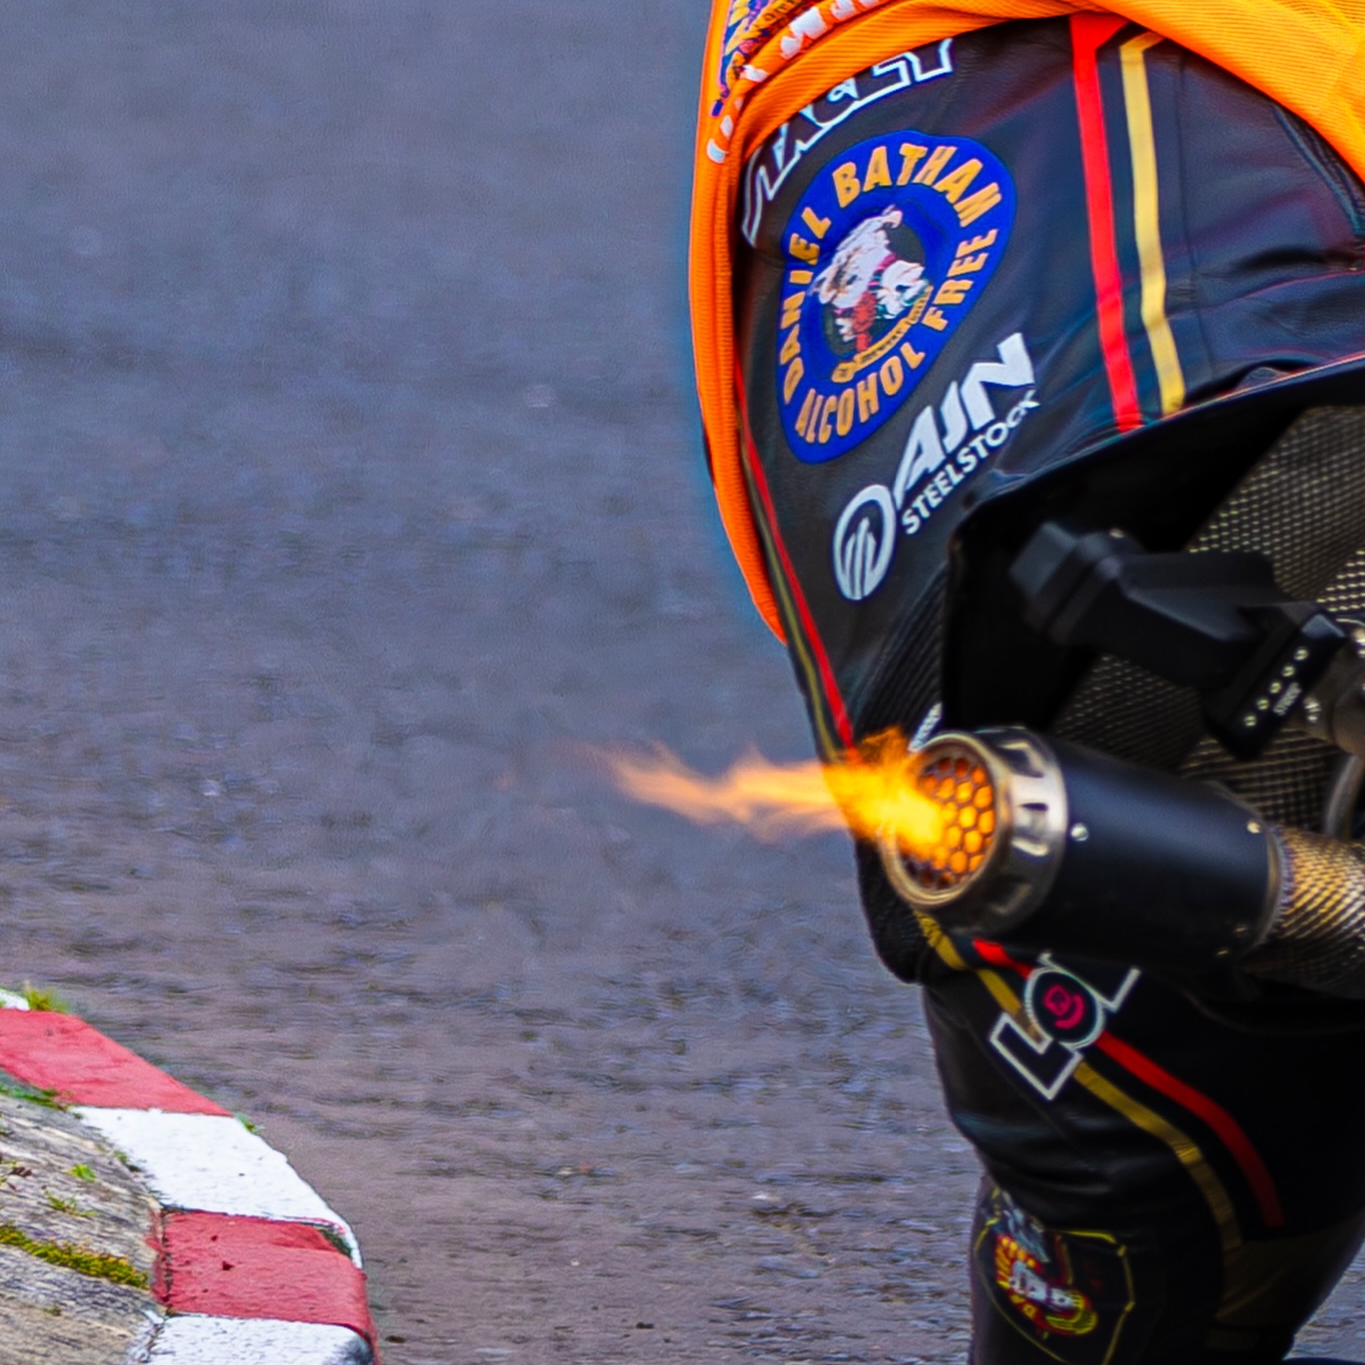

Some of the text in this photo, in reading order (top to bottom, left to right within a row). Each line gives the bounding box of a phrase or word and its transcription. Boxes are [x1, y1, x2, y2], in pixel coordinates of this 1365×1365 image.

[779, 206, 832, 405] DANIEL
[831, 142, 1003, 228] BATHAM
[794, 228, 999, 444] ALCOHOL FREE
[901, 389, 1041, 535] STEELSTOCK
